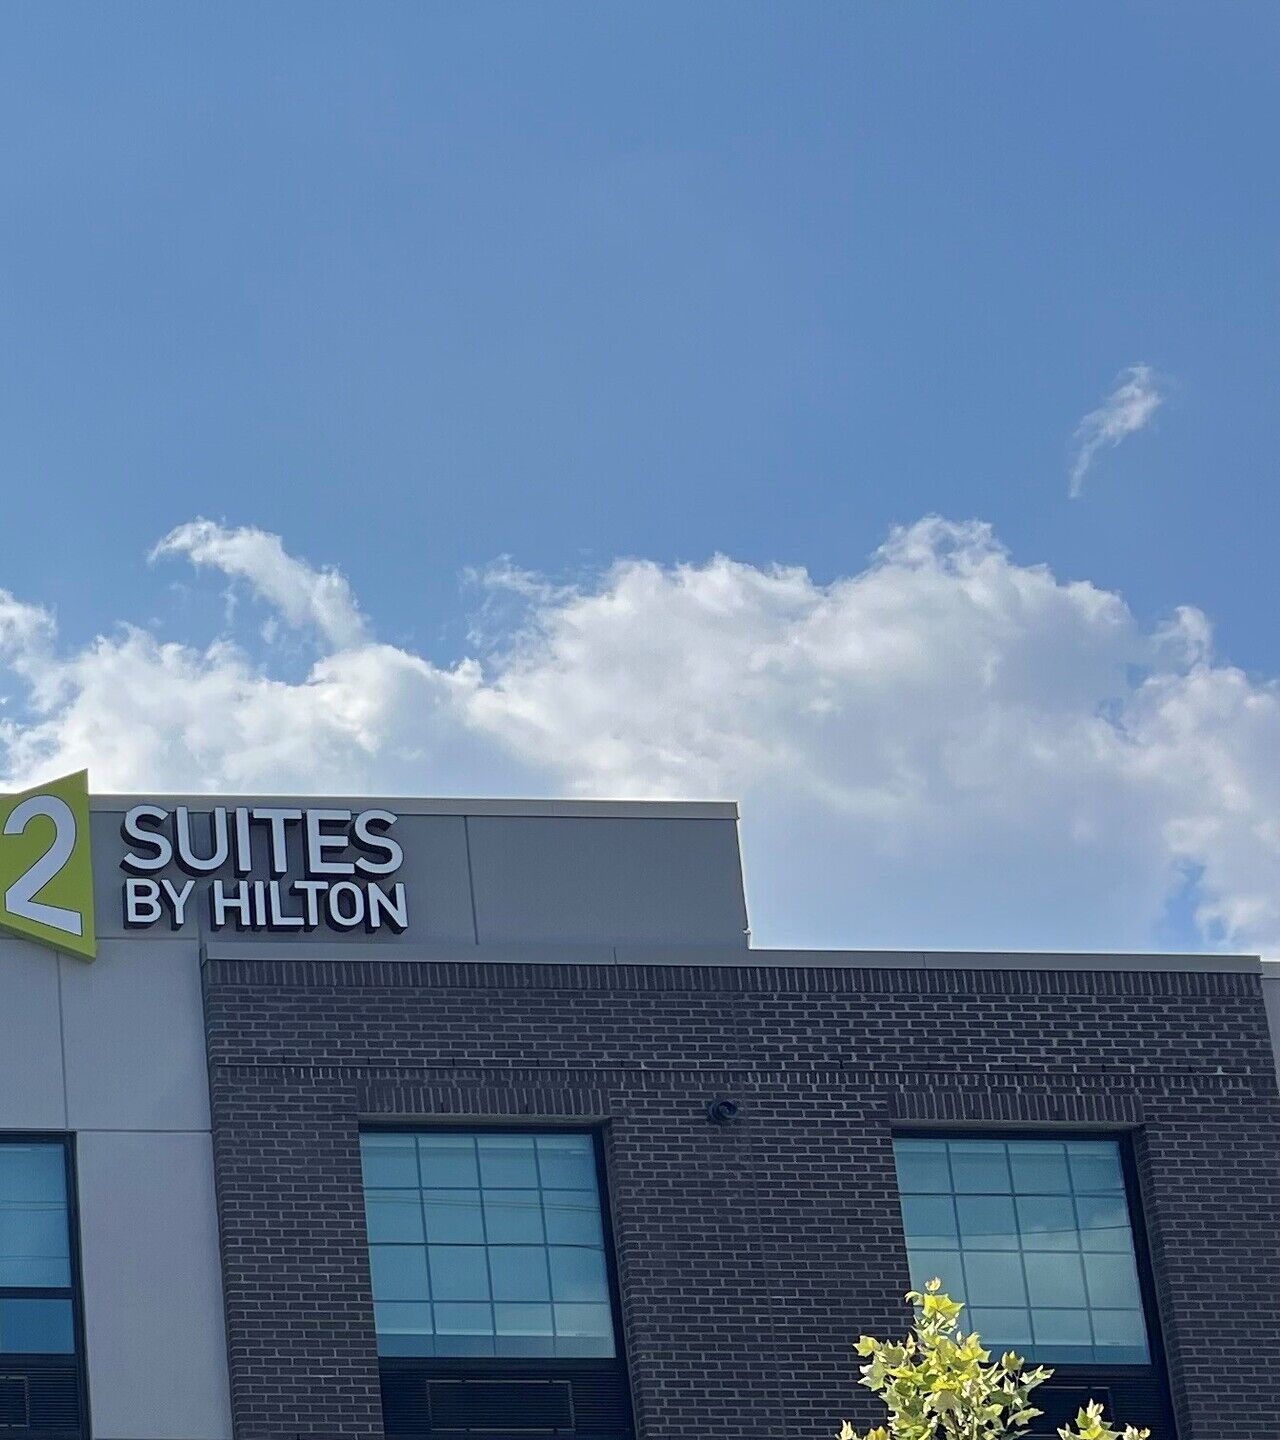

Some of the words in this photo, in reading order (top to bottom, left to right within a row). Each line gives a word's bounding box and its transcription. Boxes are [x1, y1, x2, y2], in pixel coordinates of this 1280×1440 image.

[2, 795, 83, 937] 2
[120, 805, 406, 878] SUITES
[125, 880, 197, 930] BY
[213, 881, 409, 932] HILTON
